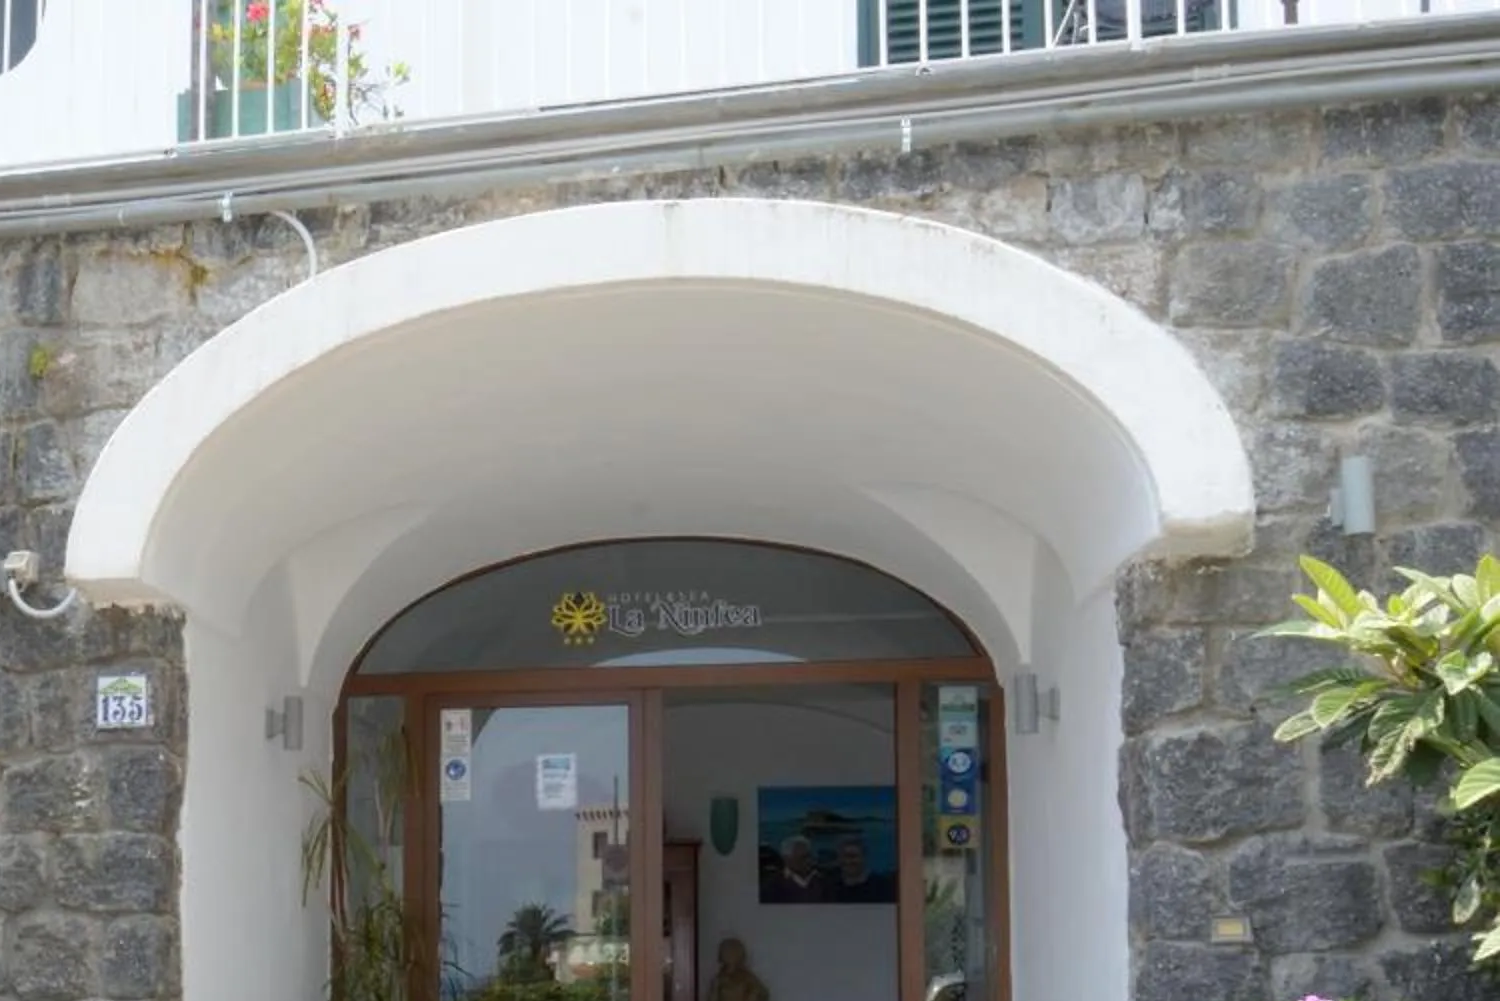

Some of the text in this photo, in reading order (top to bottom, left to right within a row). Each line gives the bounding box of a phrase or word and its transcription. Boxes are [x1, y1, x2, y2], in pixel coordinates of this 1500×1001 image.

[608, 598, 762, 637] La Ninfea
[102, 694, 143, 722] 135
